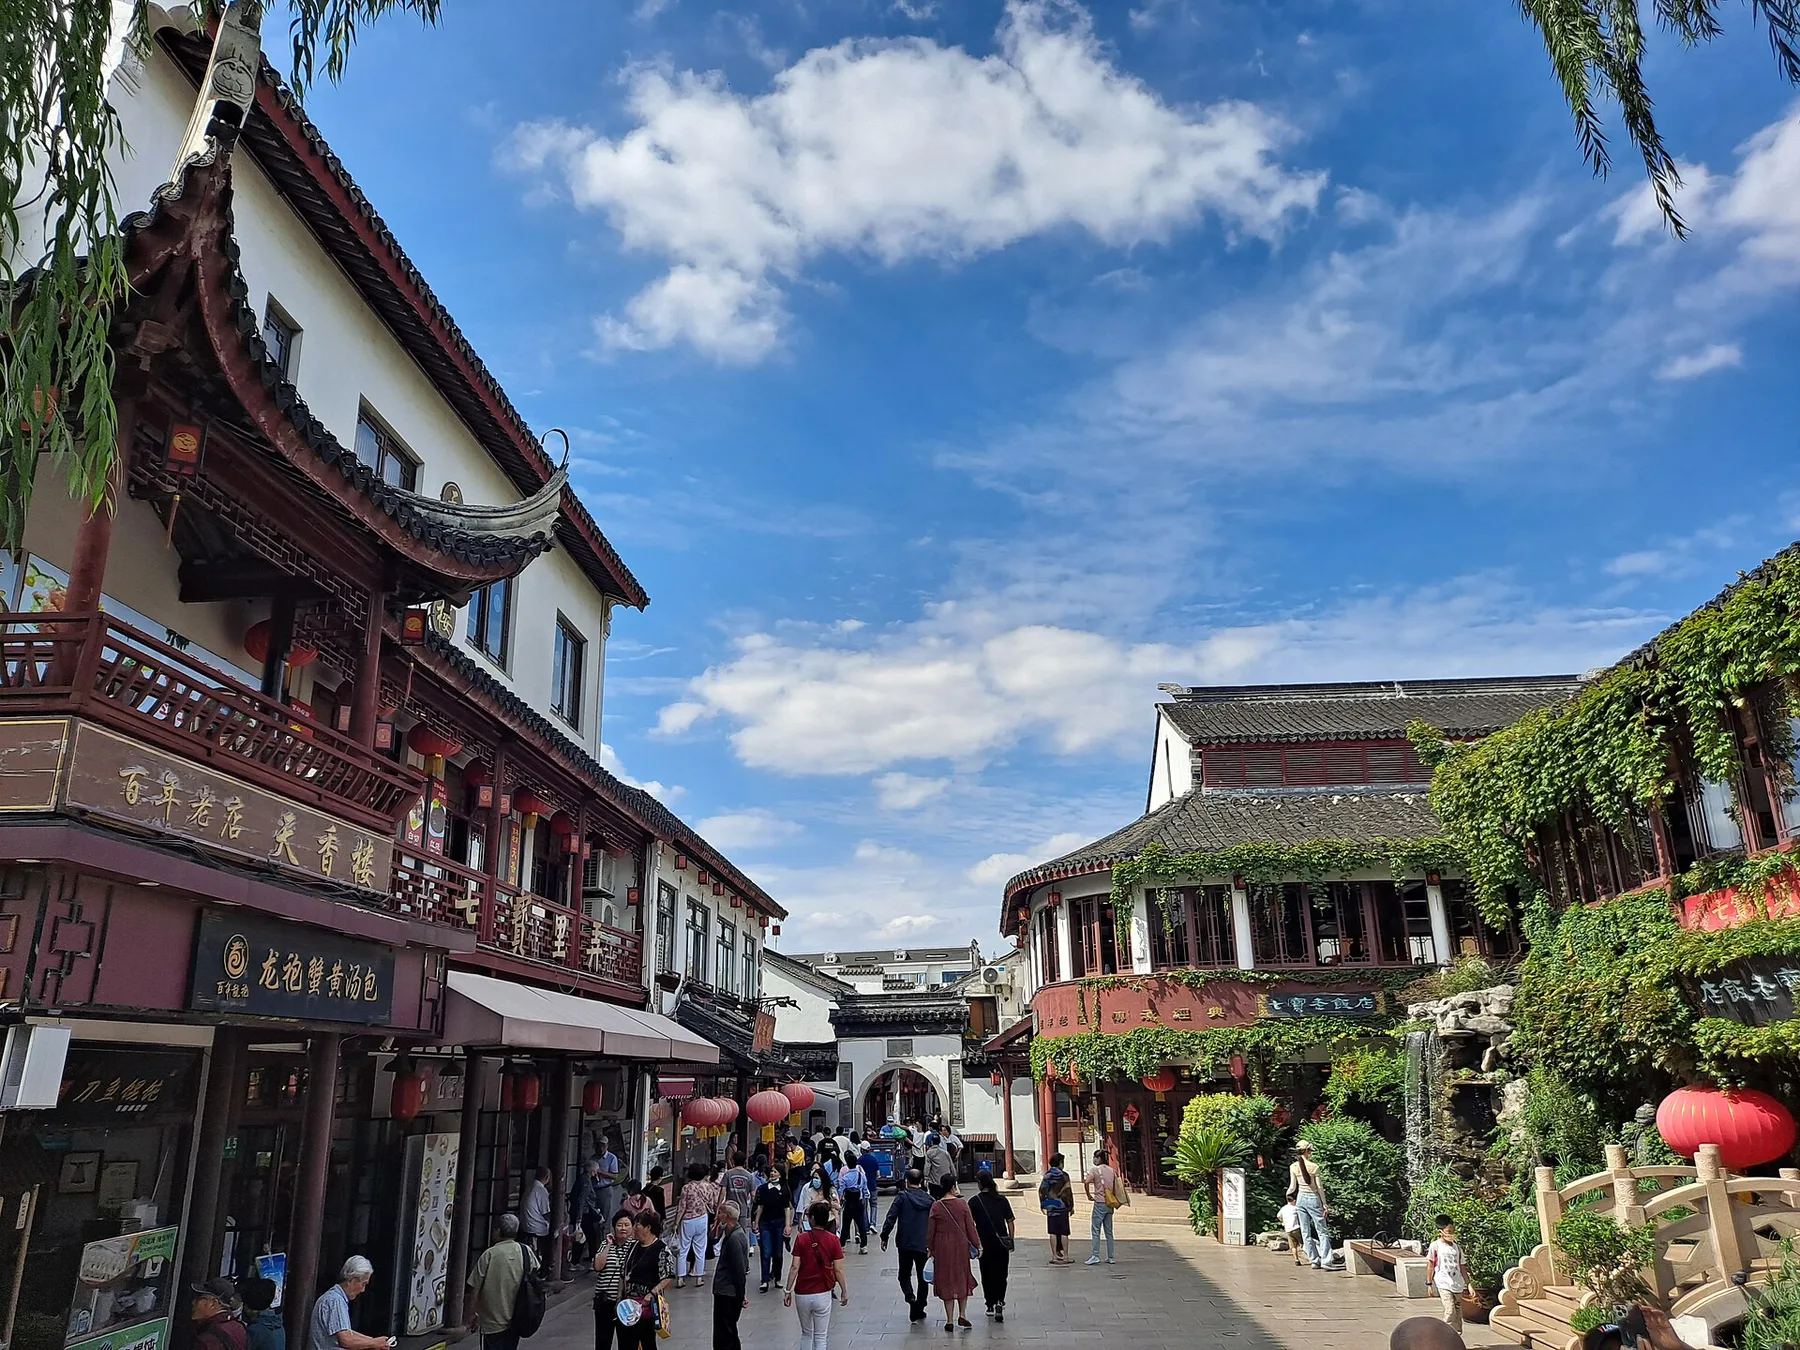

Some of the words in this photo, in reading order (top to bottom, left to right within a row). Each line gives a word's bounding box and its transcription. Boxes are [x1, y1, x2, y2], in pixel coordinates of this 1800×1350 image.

[117, 767, 246, 840] 百年老店
[271, 811, 377, 889] 天香楼
[258, 947, 378, 1002] 龙袍蟹黄汤包
[1268, 996, 1374, 1013] 七寶老飯店
[225, 1137, 237, 1150] 15
